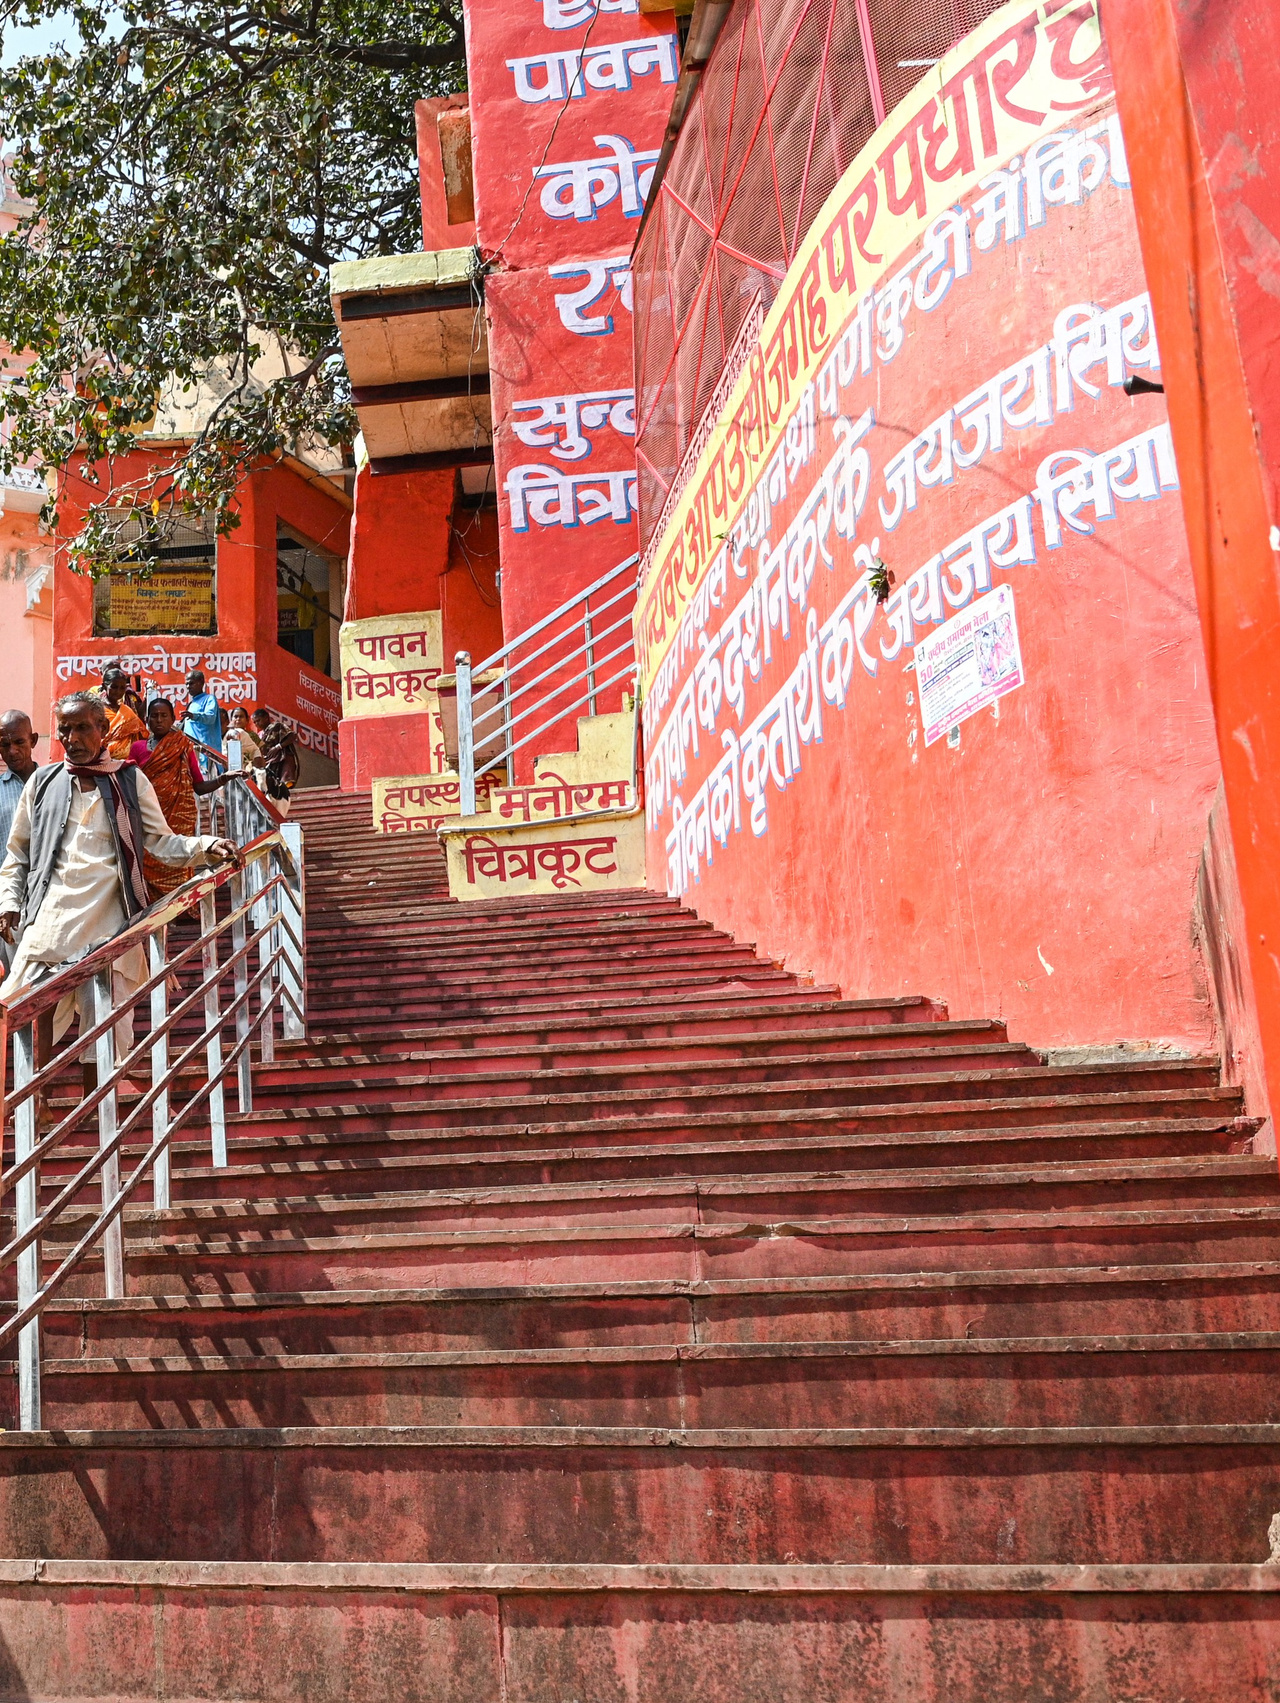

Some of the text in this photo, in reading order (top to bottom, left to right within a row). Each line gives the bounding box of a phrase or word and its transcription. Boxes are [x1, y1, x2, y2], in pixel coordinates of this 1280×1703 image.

[505, 33, 679, 105] पावन
[764, 243, 832, 426] जगह
[820, 167, 884, 296] पर
[874, 9, 1048, 219] पधार
[644, 668, 700, 833] भगवान
[718, 538, 791, 725] दर्शन
[878, 410, 956, 533] जय
[951, 345, 1054, 470] जय
[879, 553, 946, 662] जय
[941, 495, 1038, 610] जय
[120, 645, 170, 674] करने
[170, 652, 203, 672] पर
[204, 651, 257, 673] भगवान
[354, 630, 429, 662] पावन
[343, 666, 443, 704] चित्रकूट
[297, 720, 328, 756] जय
[492, 771, 630, 823] मनोरम
[460, 834, 618, 890] चित्रकूट
